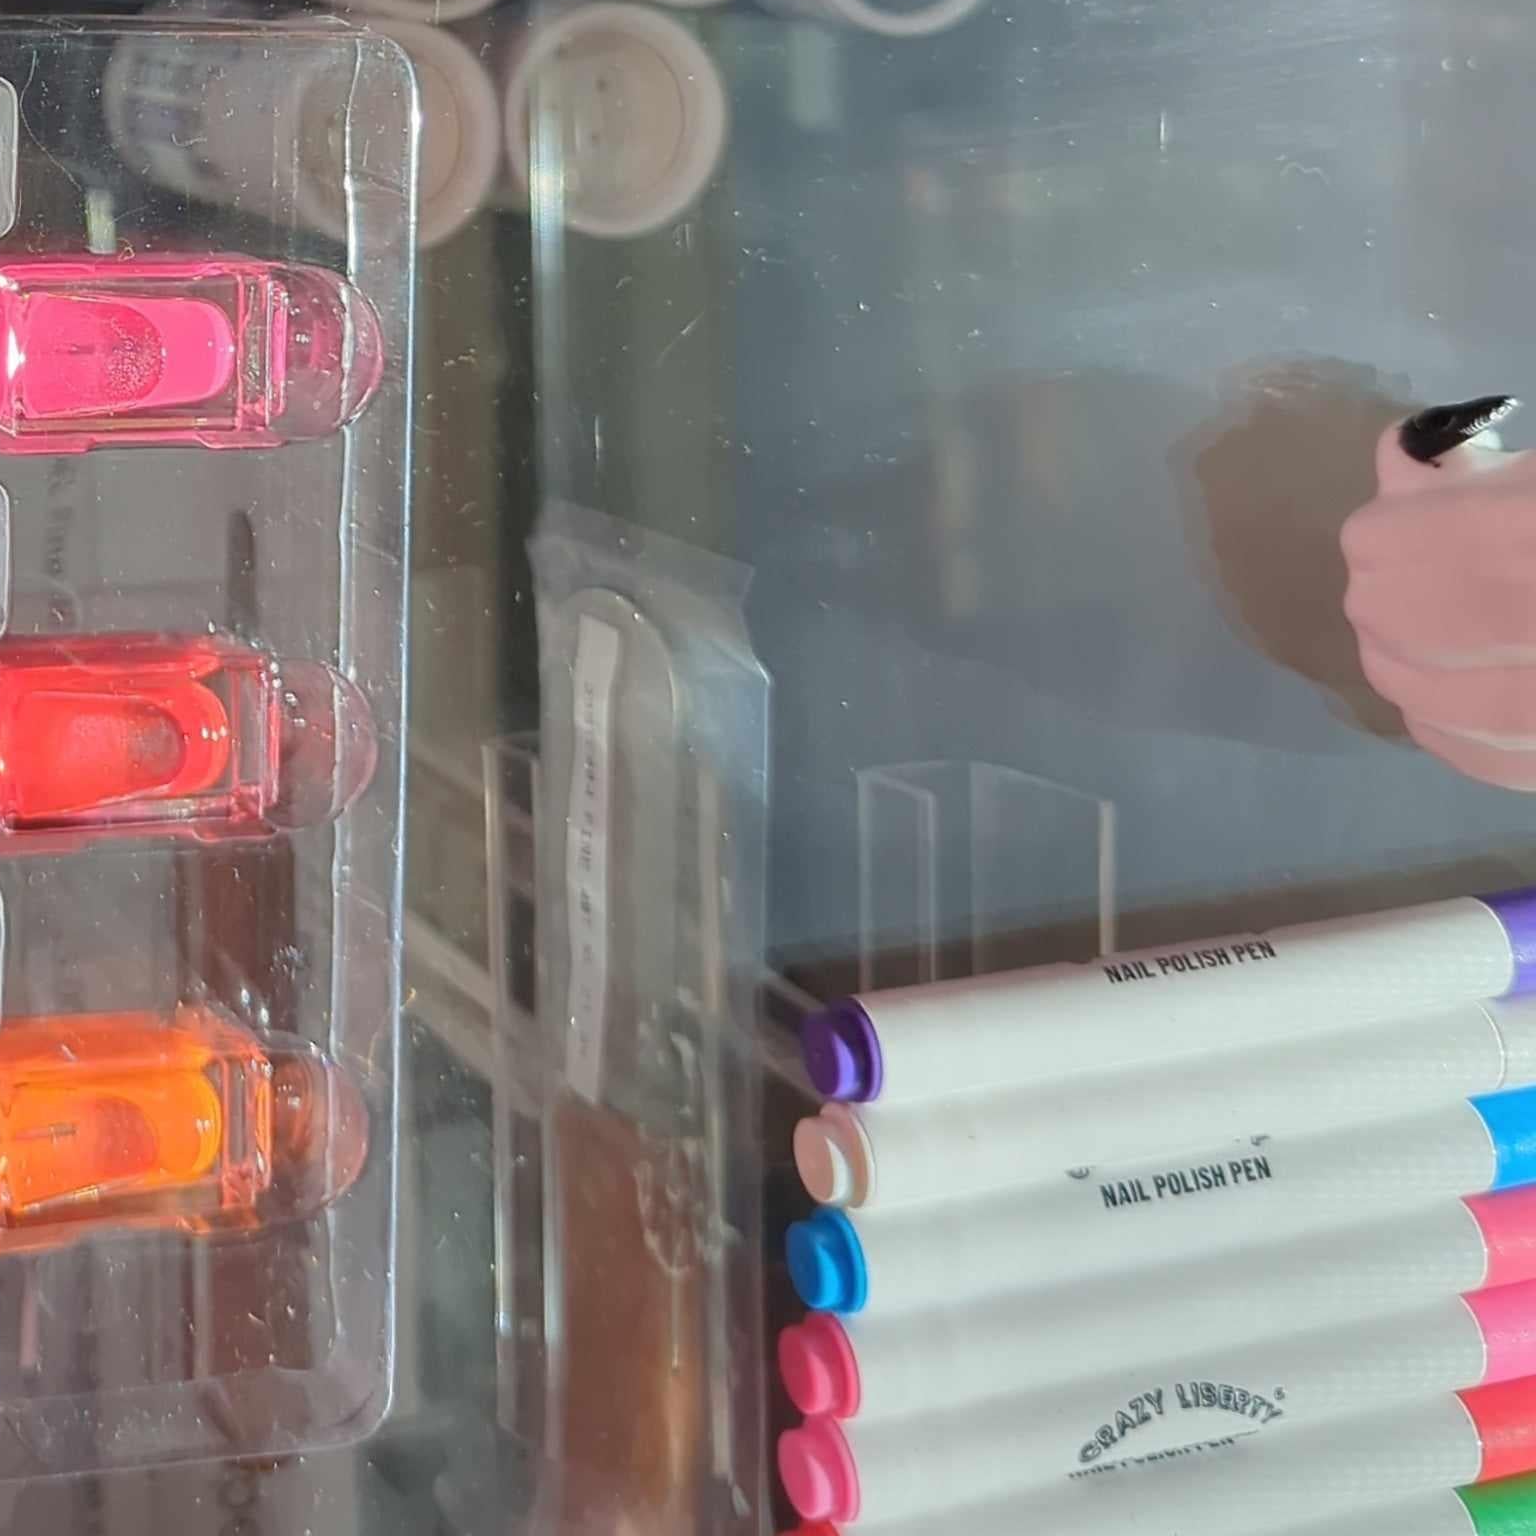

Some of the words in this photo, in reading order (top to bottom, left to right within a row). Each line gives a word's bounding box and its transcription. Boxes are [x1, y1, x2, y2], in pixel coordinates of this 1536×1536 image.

[1103, 960, 1156, 984] NAIL
[1155, 948, 1231, 975] POLISH
[1231, 940, 1277, 963] PEN
[1099, 1179, 1151, 1208] NAIL
[1152, 1163, 1227, 1198] POLISH
[1228, 1155, 1272, 1184] PEN
[1078, 1387, 1164, 1463] CRAZY
